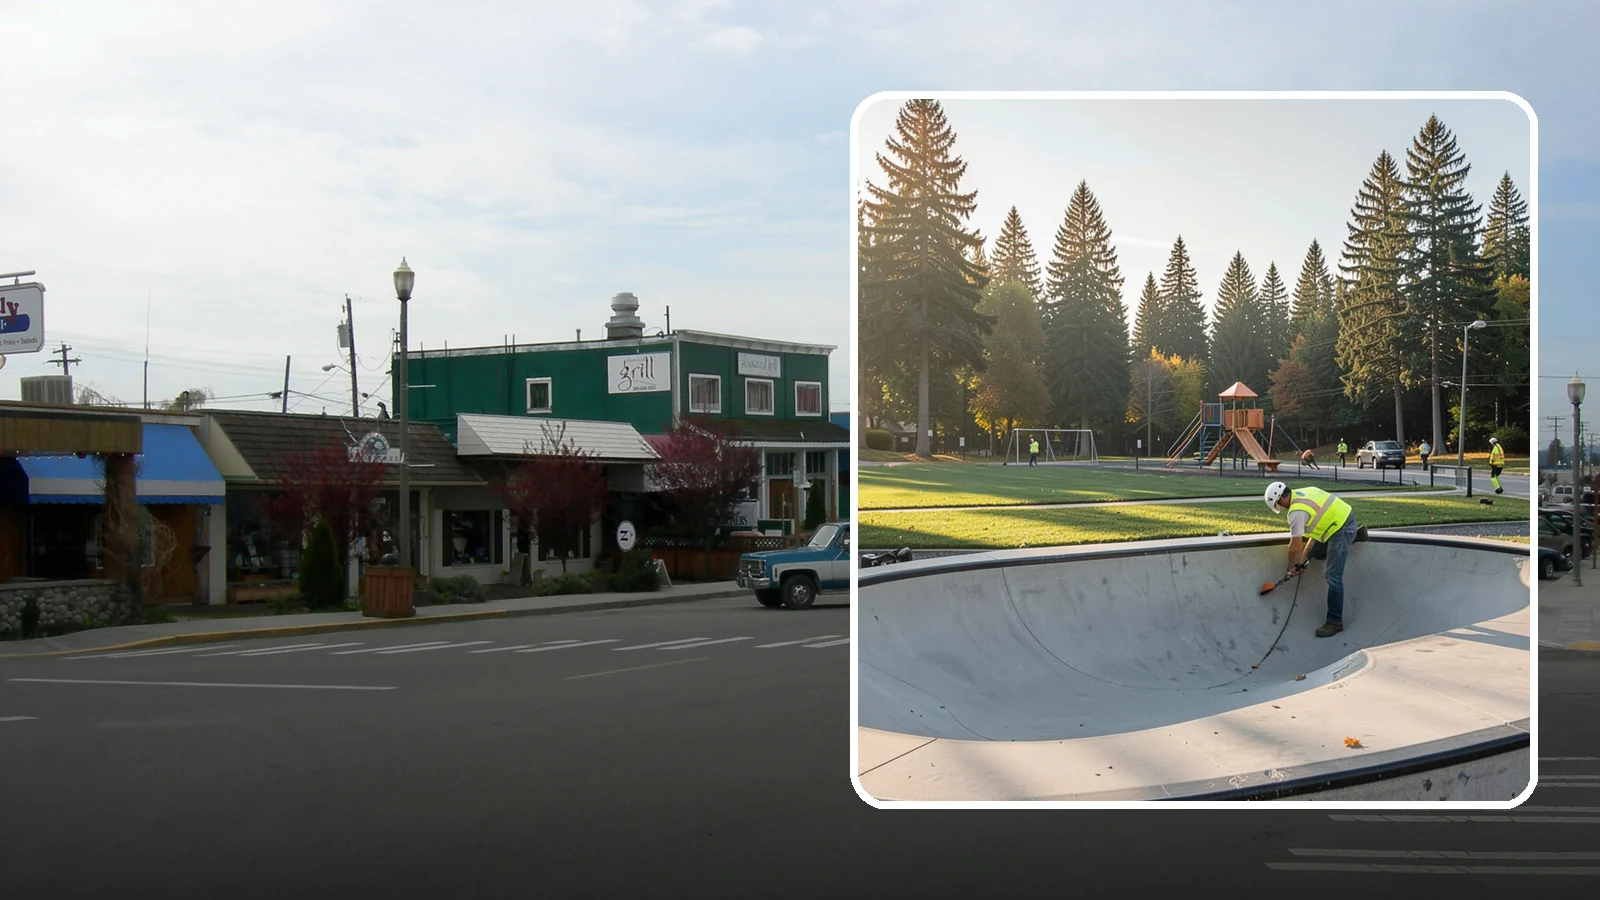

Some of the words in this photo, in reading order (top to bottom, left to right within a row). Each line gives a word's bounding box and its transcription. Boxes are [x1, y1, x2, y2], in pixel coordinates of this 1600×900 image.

[3, 338, 16, 346] Fries
[20, 336, 38, 345] Salads
[617, 355, 655, 392] grill
